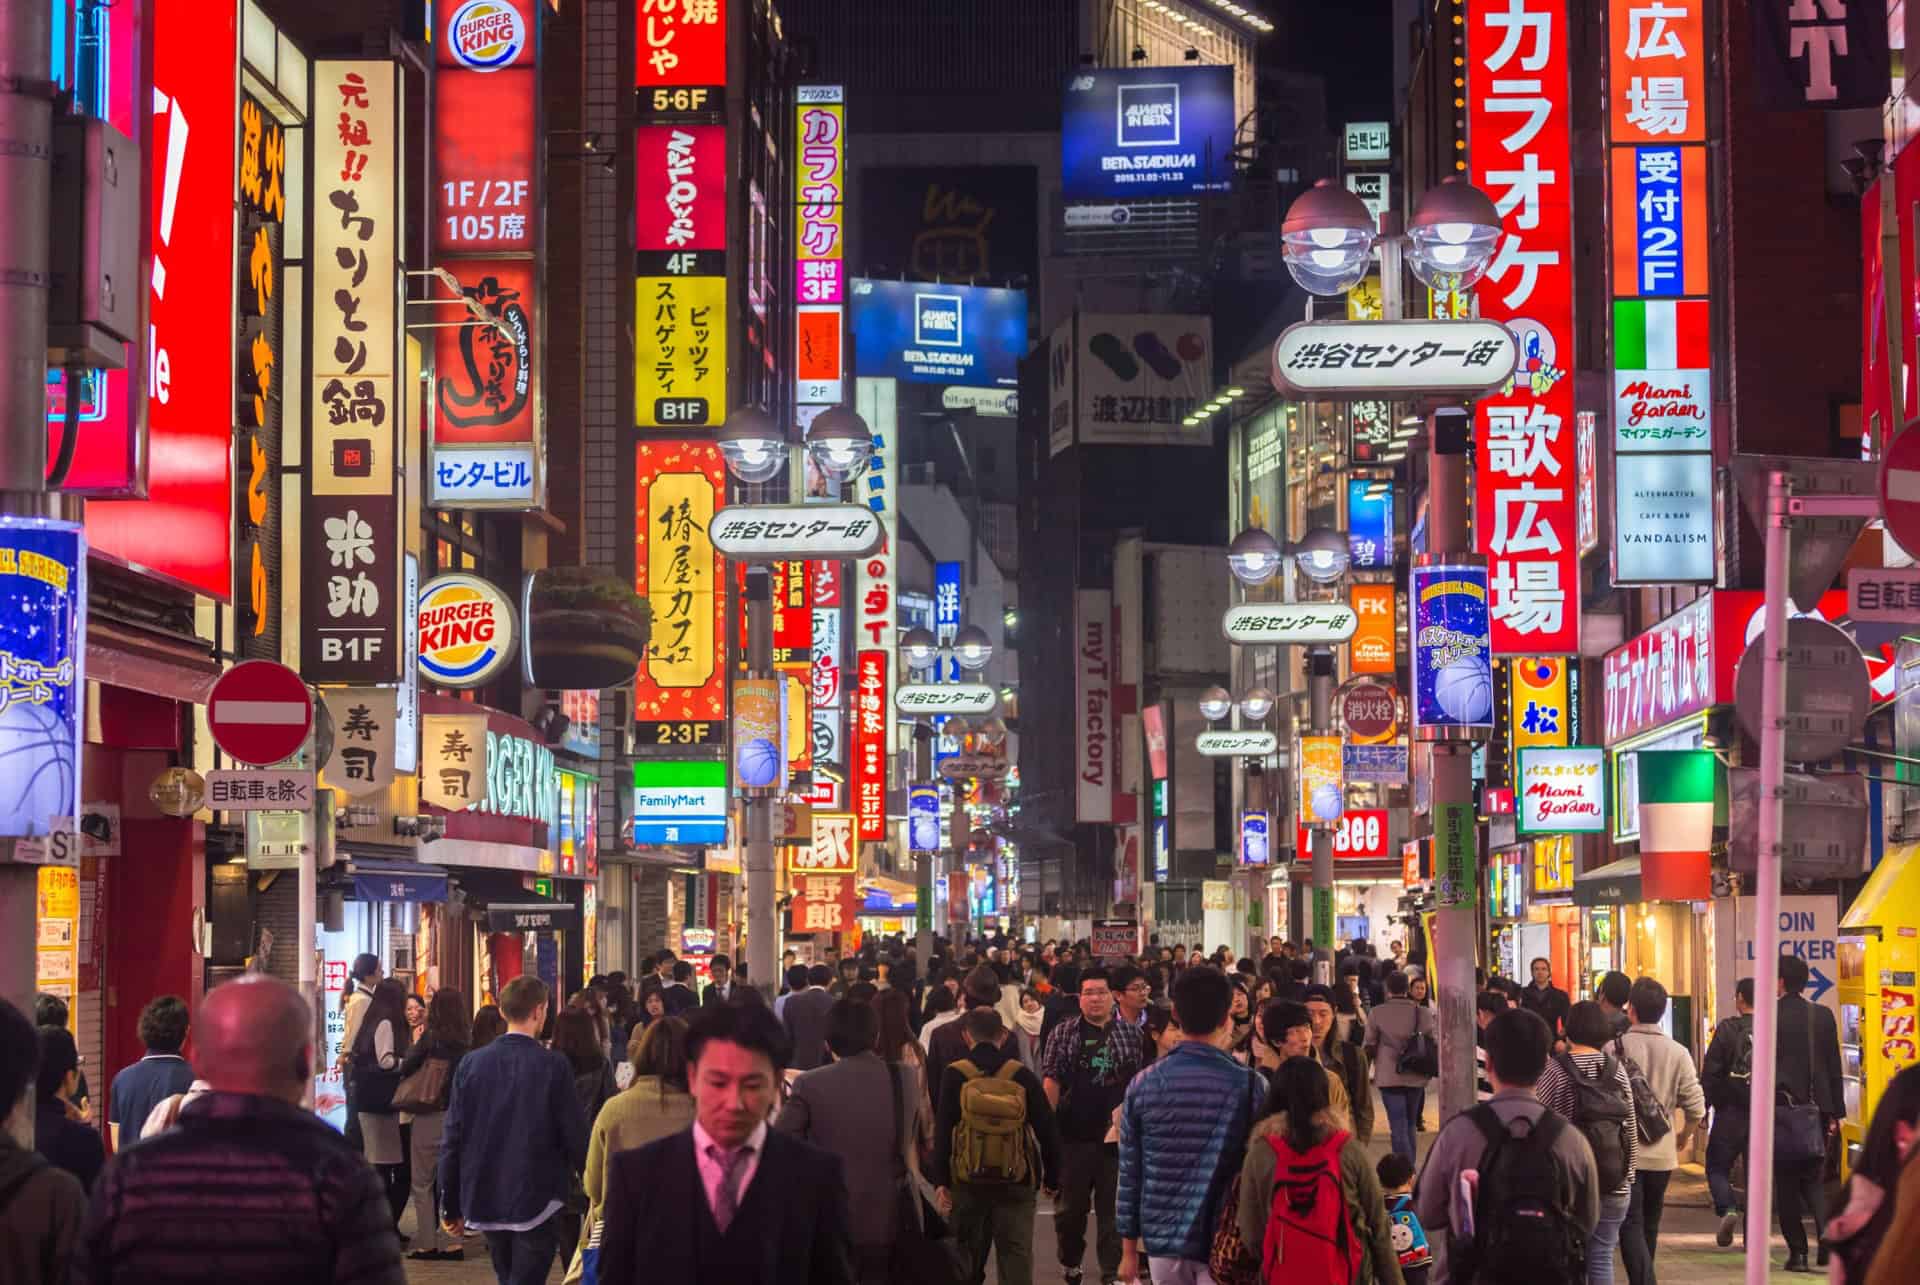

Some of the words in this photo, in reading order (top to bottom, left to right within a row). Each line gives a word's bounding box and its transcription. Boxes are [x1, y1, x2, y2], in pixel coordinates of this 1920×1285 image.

[459, 12, 513, 38] BURGER
[461, 25, 514, 53] KING
[1624, 3, 1688, 135] 広場
[1483, 3, 1559, 310] カラオケ
[803, 110, 839, 256] カラオケ
[447, 215, 526, 240] 105席
[666, 254, 697, 274] 4F
[803, 262, 836, 278] 受付
[804, 280, 836, 299] 3F
[656, 282, 678, 392] スパゲッティ
[690, 307, 711, 381] ピッツァ
[1286, 339, 1504, 370] 渋谷センター街
[810, 385, 827, 396] 2F
[1620, 380, 1692, 400] Miami
[662, 403, 701, 420] B1F
[1619, 427, 1707, 440] マイアミガーデン
[437, 461, 531, 488] センタービル
[719, 519, 872, 541] 渋谷センター街
[1486, 404, 1565, 634] 歌広場
[1624, 533, 1708, 543] VANDALISM
[324, 510, 379, 618] 米助
[418, 602, 494, 630] BURGER
[1358, 598, 1387, 614] FK
[1231, 612, 1350, 633] 渋谷センター街
[419, 618, 495, 655] KING
[321, 638, 382, 662] B1F
[1607, 606, 1710, 741] カラオケ歌広場
[900, 691, 991, 705] 渋谷センター街
[1348, 700, 1392, 722] 消火栓
[1522, 701, 1559, 734] 松
[341, 704, 379, 782] 寿司
[1082, 689, 1108, 787] factory
[440, 729, 473, 799] 寿司
[480, 731, 535, 820] RGER
[212, 780, 308, 802] 自転車を除く
[640, 794, 705, 808] FamilyMart
[862, 783, 880, 795] 2F
[1525, 782, 1585, 798] Miami
[862, 801, 880, 813] 3F
[862, 820, 880, 832] 4F
[805, 876, 842, 930] 野郎
[1778, 911, 1815, 932] OIN
[1747, 940, 1836, 961] LCKER
